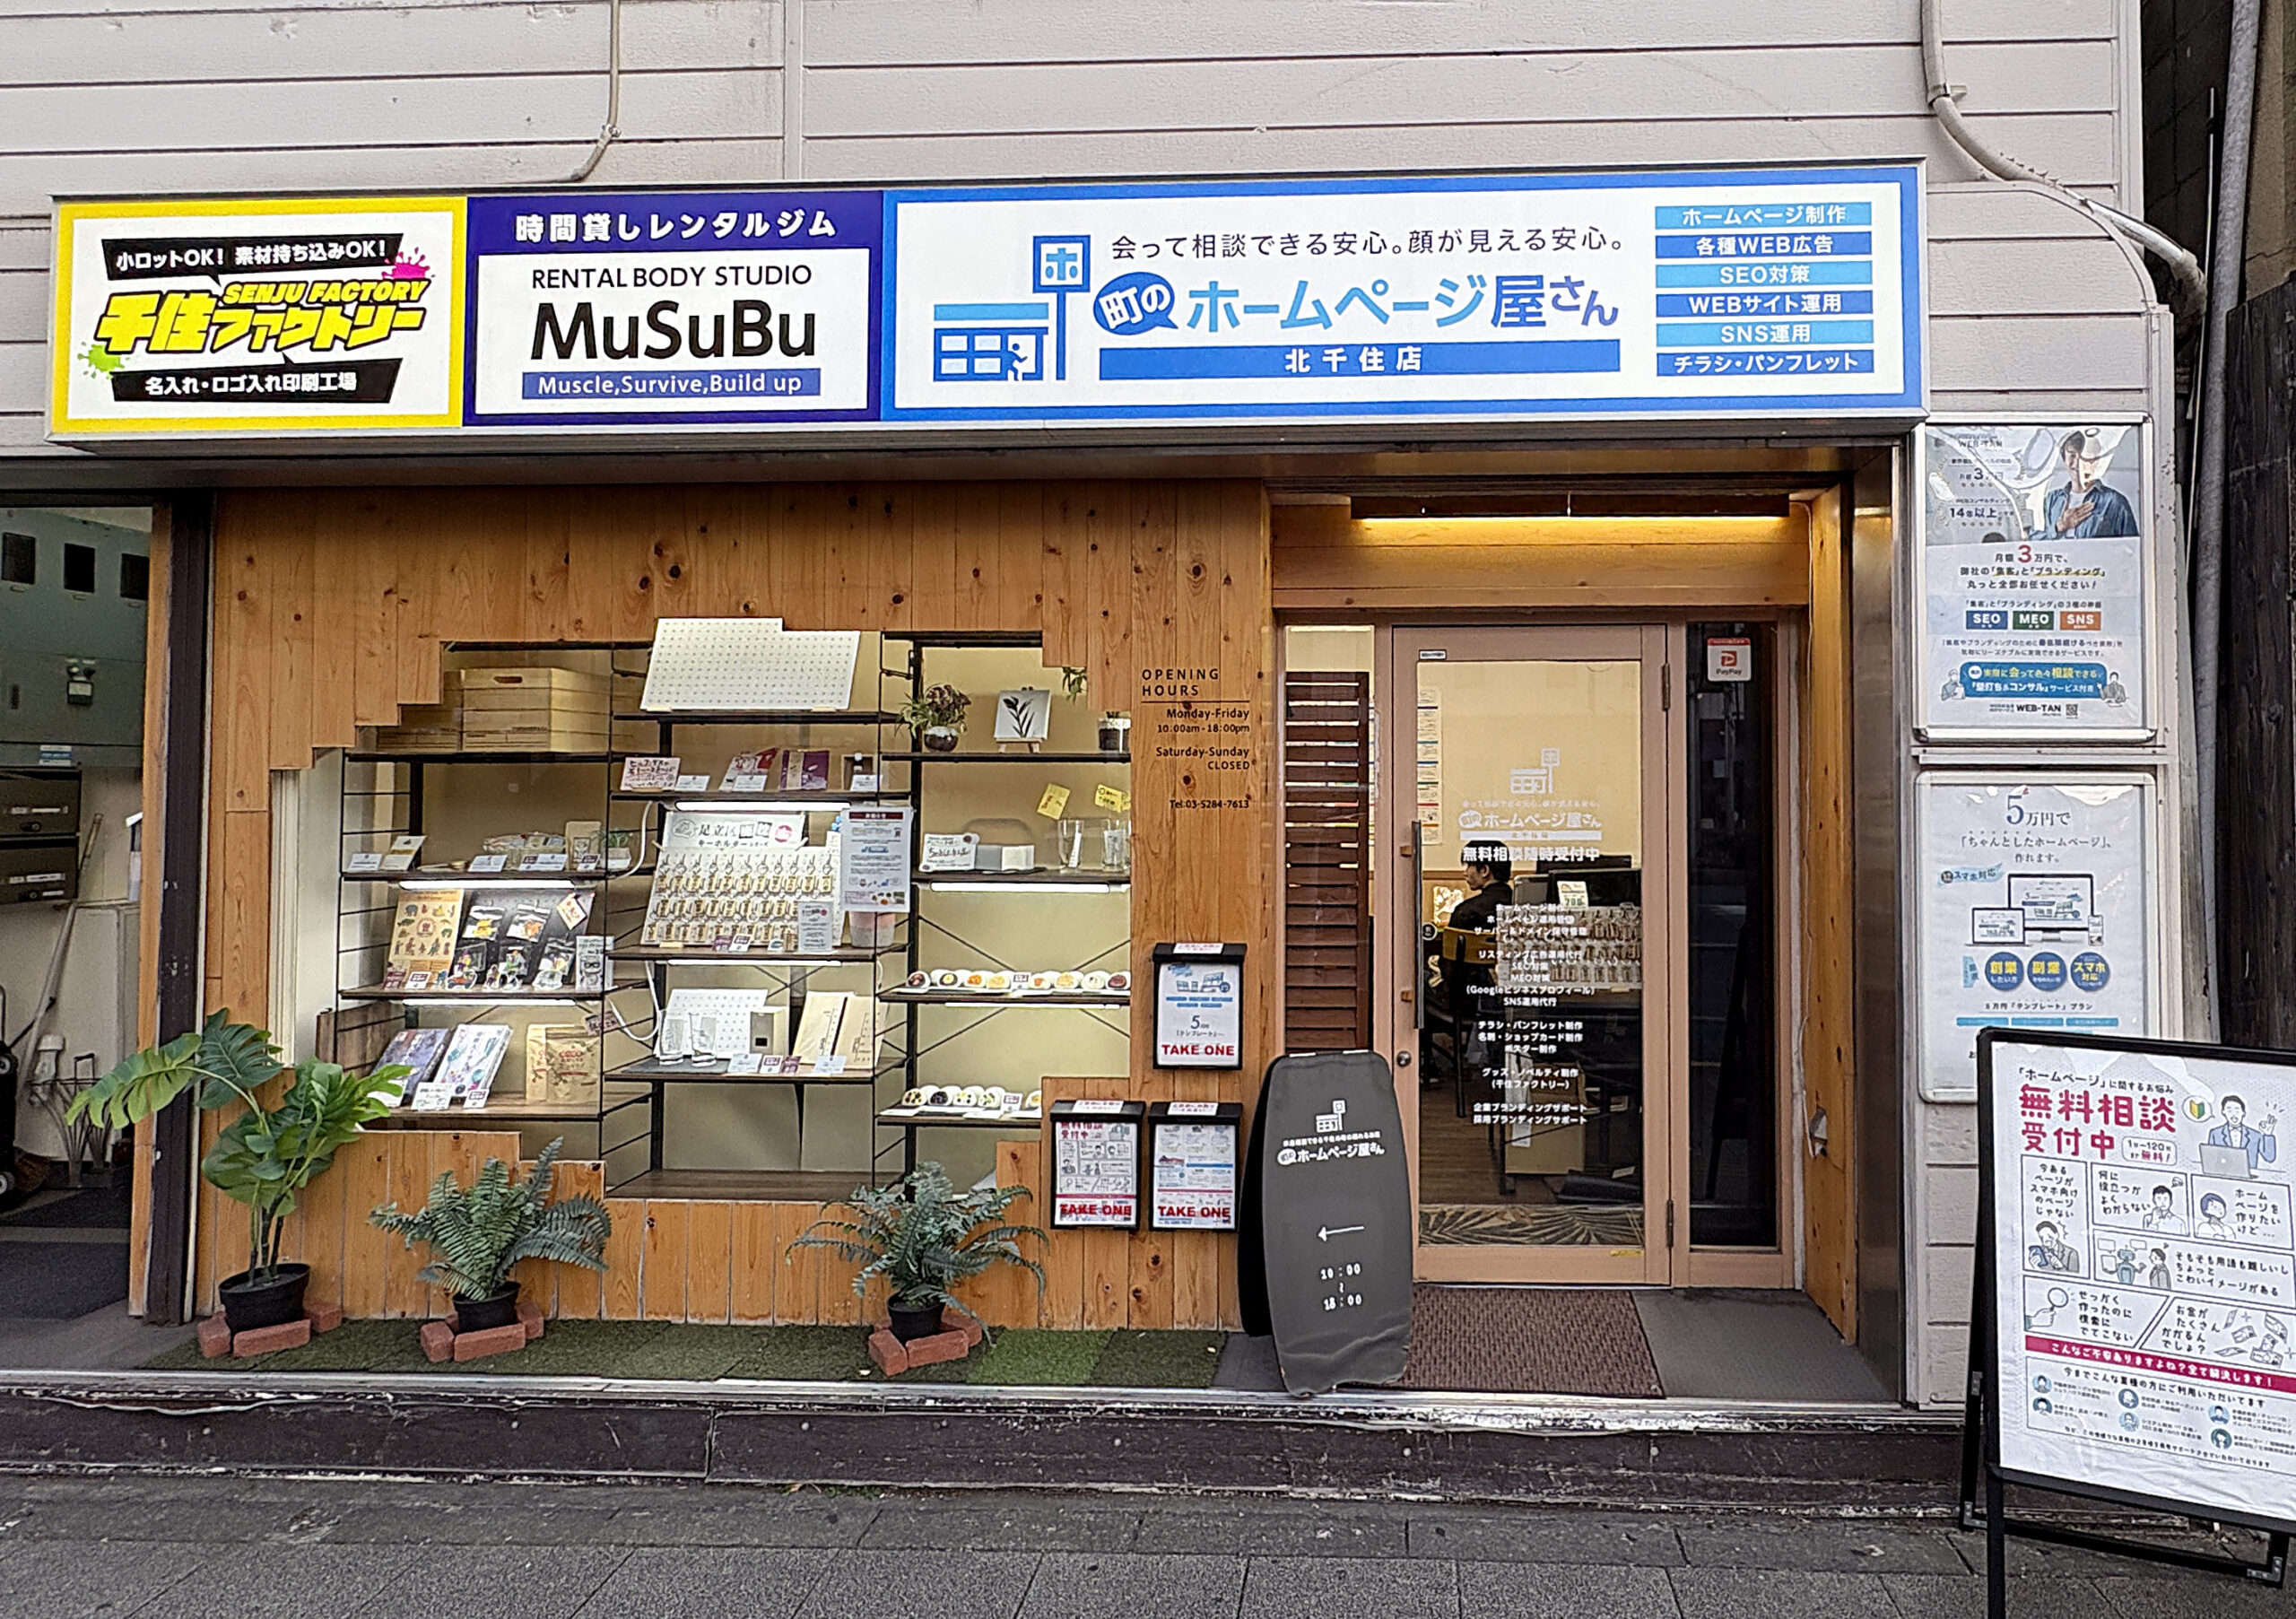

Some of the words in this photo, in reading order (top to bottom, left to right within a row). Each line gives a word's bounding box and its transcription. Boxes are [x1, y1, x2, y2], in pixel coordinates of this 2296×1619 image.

[1683, 205, 1847, 227] ホームページ制作
[515, 210, 836, 243] 時間貸しレンタルジム
[1696, 235, 1833, 257] 各種WEB広告
[533, 268, 627, 289] RENTAL
[633, 267, 705, 287] BODY
[715, 265, 812, 286] STUDIO
[1719, 265, 1810, 284] SEO対策
[222, 281, 308, 305] SENJU
[309, 279, 429, 304] FACTORY
[1187, 274, 1619, 333] ホームページ屋さん
[1689, 293, 1842, 314] WEBサイト運用
[95, 291, 425, 353] 千住ファクトリー
[531, 300, 814, 360] MuSuBu
[1721, 323, 1811, 344] SNS運用
[1285, 345, 1422, 375] 北千住店
[1674, 353, 1858, 374] チラシ・パンフレット
[145, 372, 357, 396] 名入れ・ロゴ入れ印刷工場
[774, 373, 802, 396] up
[1973, 614, 2000, 624] SEO
[2020, 614, 2049, 624] MEO
[2067, 614, 2093, 624] SNS
[1142, 668, 1219, 680] OPENING
[1143, 685, 1199, 696] HOURS
[1167, 709, 1249, 720] Monday-Friday
[2016, 704, 2061, 712] WEB-TAN
[1156, 746, 1249, 758] Saturday-Sunday
[1208, 762, 1249, 770] CLOSED
[2006, 795, 2071, 826] 5万円で
[2074, 962, 2105, 973] スマホ
[1161, 1044, 1200, 1055] TAKE
[1205, 1045, 1235, 1056] ONE
[2019, 1084, 2176, 1133] 無料相談
[2022, 1122, 2114, 1160] 受付中
[2235, 1188, 2267, 1200] ホーム
[1060, 1204, 1097, 1215] TAKE
[1102, 1204, 1132, 1216] ONE
[1158, 1206, 1196, 1217] TAKE
[1200, 1206, 1231, 1218] ONE
[2236, 1213, 2281, 1224] 作りたい
[2177, 1263, 2214, 1275] ちょっと
[2079, 1291, 2119, 1305] せっかく
[2177, 1318, 2220, 1333] たくさん
